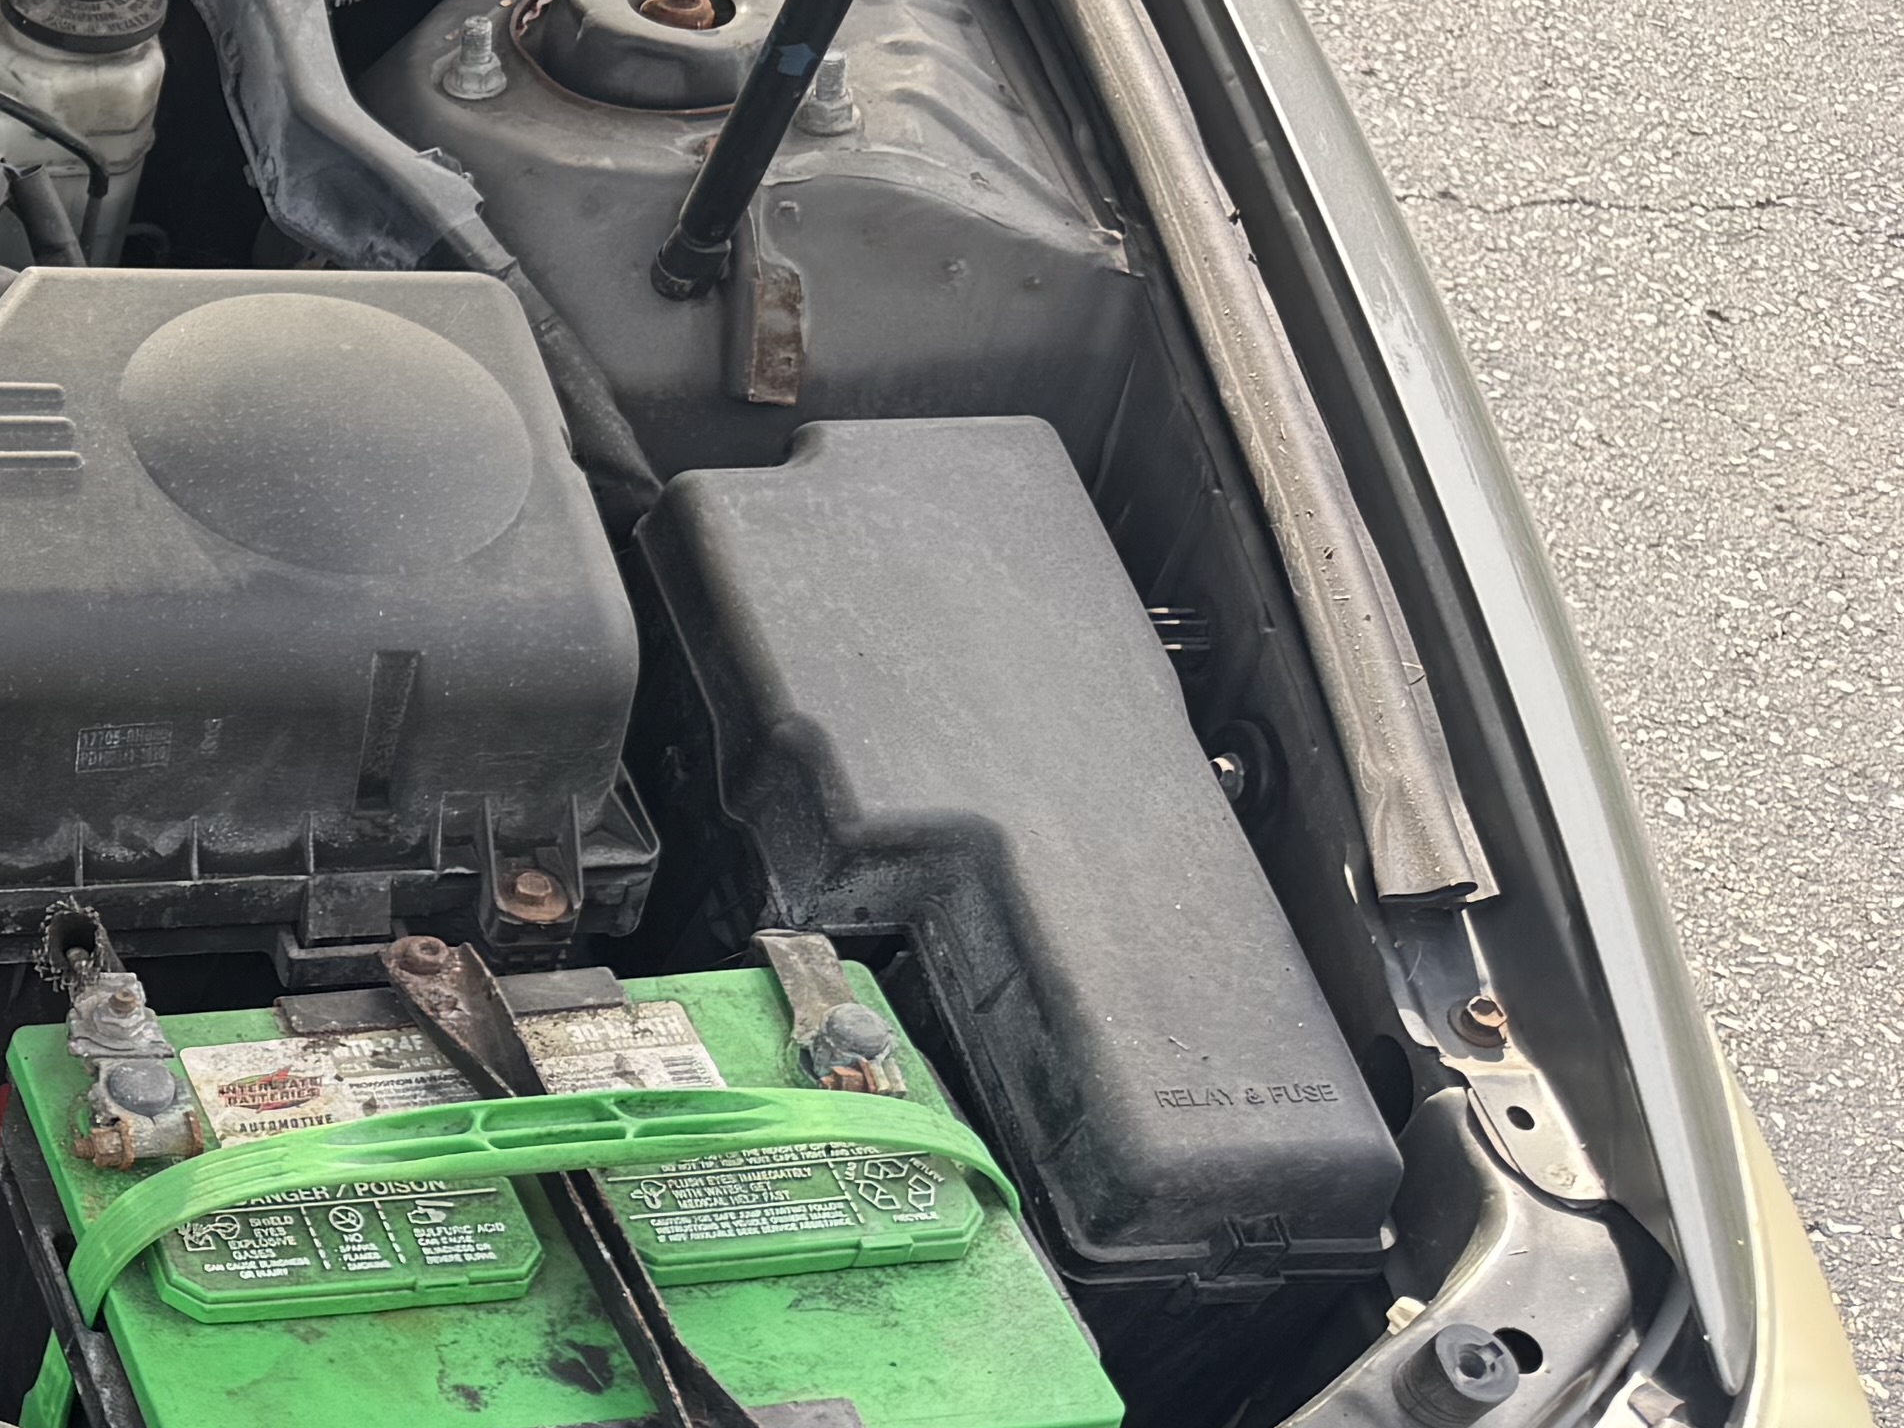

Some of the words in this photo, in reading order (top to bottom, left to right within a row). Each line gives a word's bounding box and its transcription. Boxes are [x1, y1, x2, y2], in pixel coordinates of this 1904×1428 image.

[225, 1088, 319, 1106] BATTERIES
[1154, 1088, 1234, 1108] RELAY
[1245, 1088, 1265, 1105] &
[1268, 1084, 1338, 1104] FUSE
[240, 1113, 333, 1133] AUTOMOTIVE
[709, 1174, 737, 1187] EYES
[739, 1167, 812, 1182] IMMEDIATELY
[238, 1186, 330, 1205] ANGER
[354, 1180, 447, 1196] POISON
[672, 1188, 702, 1200] WITH
[749, 1181, 773, 1193] GET
[676, 1198, 728, 1209] MEDICAL
[732, 1194, 758, 1206] HELP
[762, 1189, 791, 1202] FAST
[808, 1202, 845, 1213] FOLLOW
[249, 1215, 294, 1227] SHIELD
[892, 1211, 939, 1222] RECYCLE
[254, 1226, 287, 1237] EYES
[413, 1224, 471, 1238] SULFURIC
[477, 1222, 505, 1233] ACID
[227, 1236, 297, 1249] EXPLOSIVE
[343, 1233, 364, 1244] NO
[417, 1237, 440, 1246] CAN
[232, 1249, 277, 1260] GASES
[204, 1263, 225, 1273] CAN
[226, 1260, 258, 1272] CAUSE
[240, 1270, 255, 1280] OR
[256, 1268, 289, 1278] INJURY
